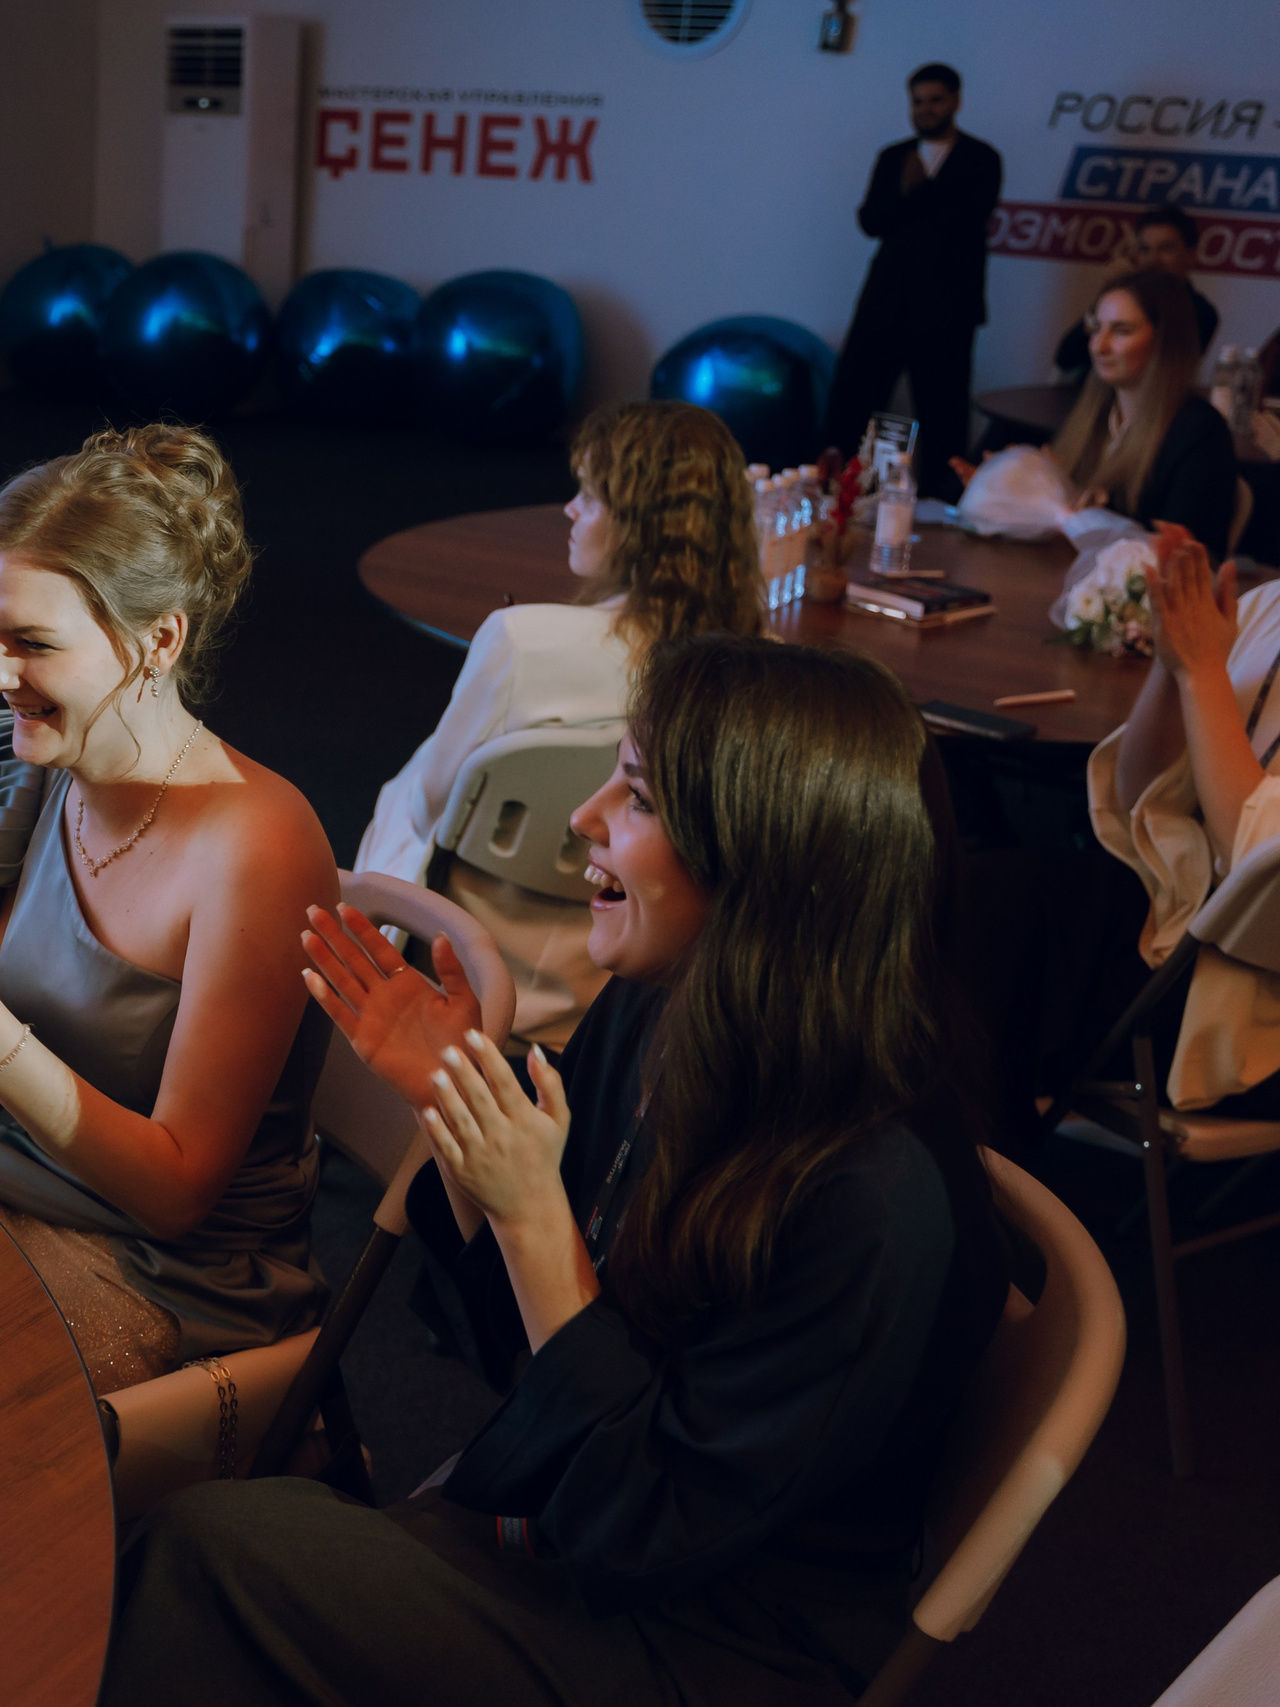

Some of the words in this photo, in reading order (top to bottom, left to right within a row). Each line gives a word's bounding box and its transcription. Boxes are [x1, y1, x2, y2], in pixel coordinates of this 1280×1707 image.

[1047, 91, 1266, 140] РОССИЯ
[316, 109, 598, 183] СЕНЕЖ
[1073, 155, 1280, 208] СТРАНА
[986, 207, 1280, 271] ОЗМООС
